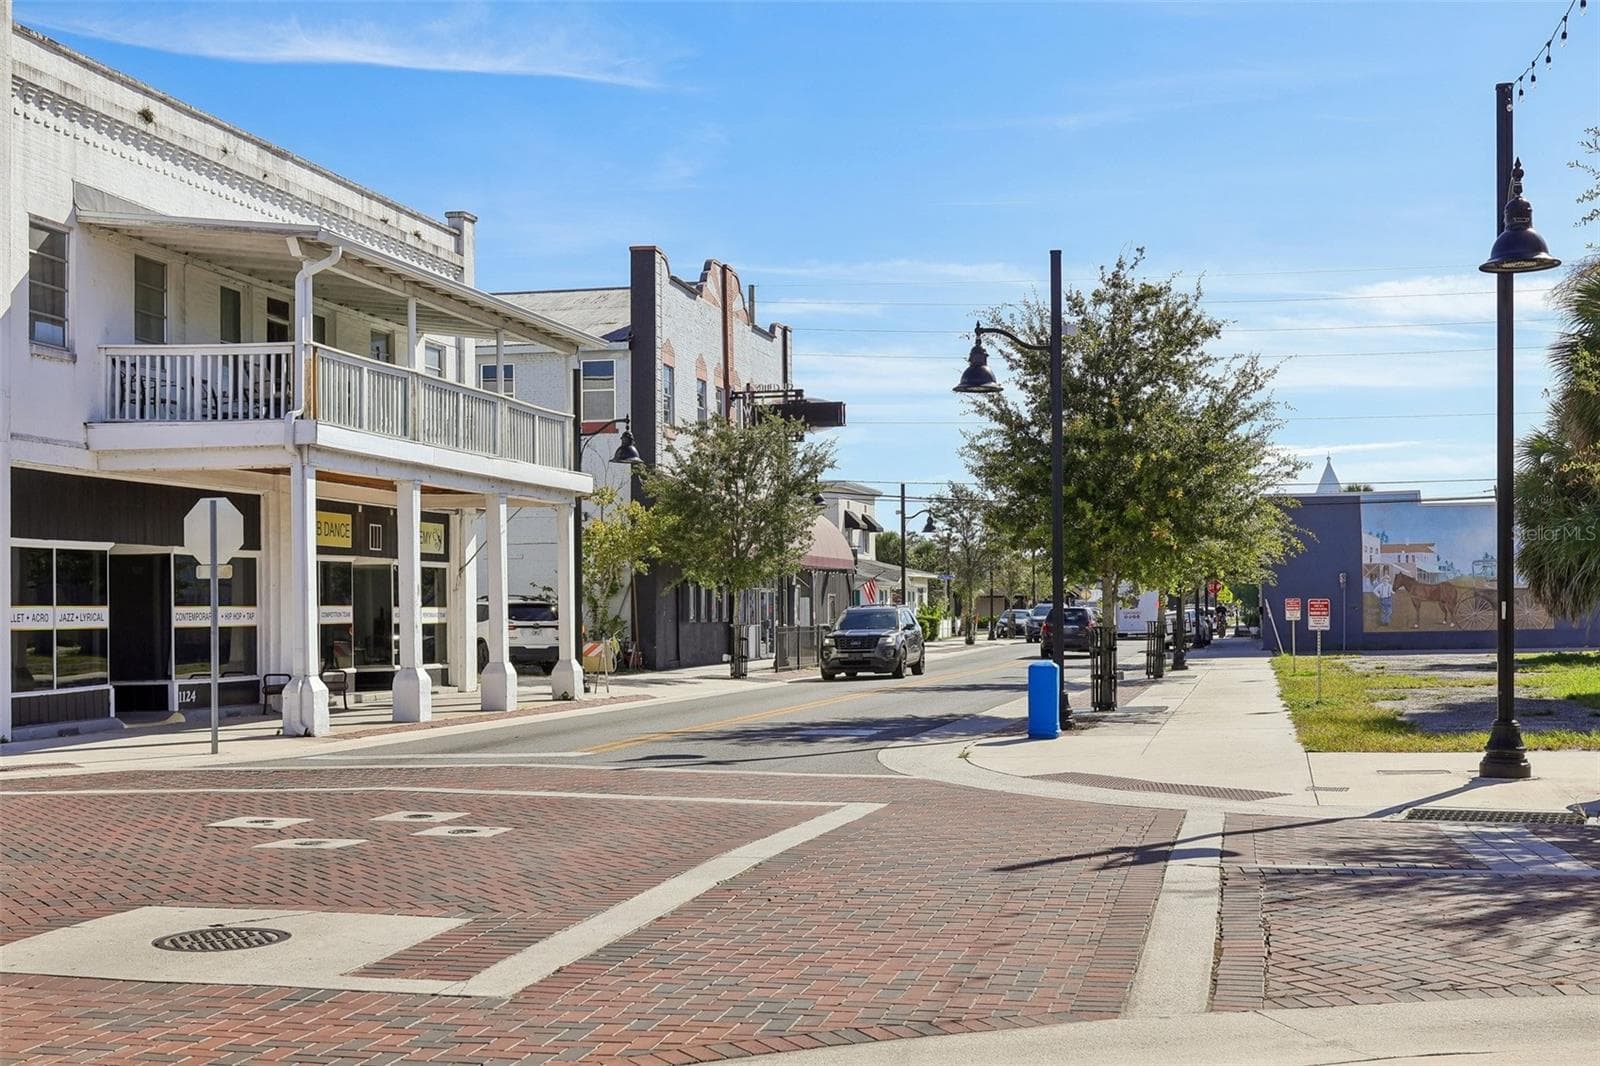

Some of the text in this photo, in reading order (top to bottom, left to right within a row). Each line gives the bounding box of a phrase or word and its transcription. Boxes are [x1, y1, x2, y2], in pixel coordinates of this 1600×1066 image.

[324, 521, 350, 539] DANCE
[32, 613, 49, 622] ACRO
[59, 612, 105, 622] JAZZ LYRICAL
[246, 612, 255, 620] TAP
[178, 690, 197, 703] 1124
